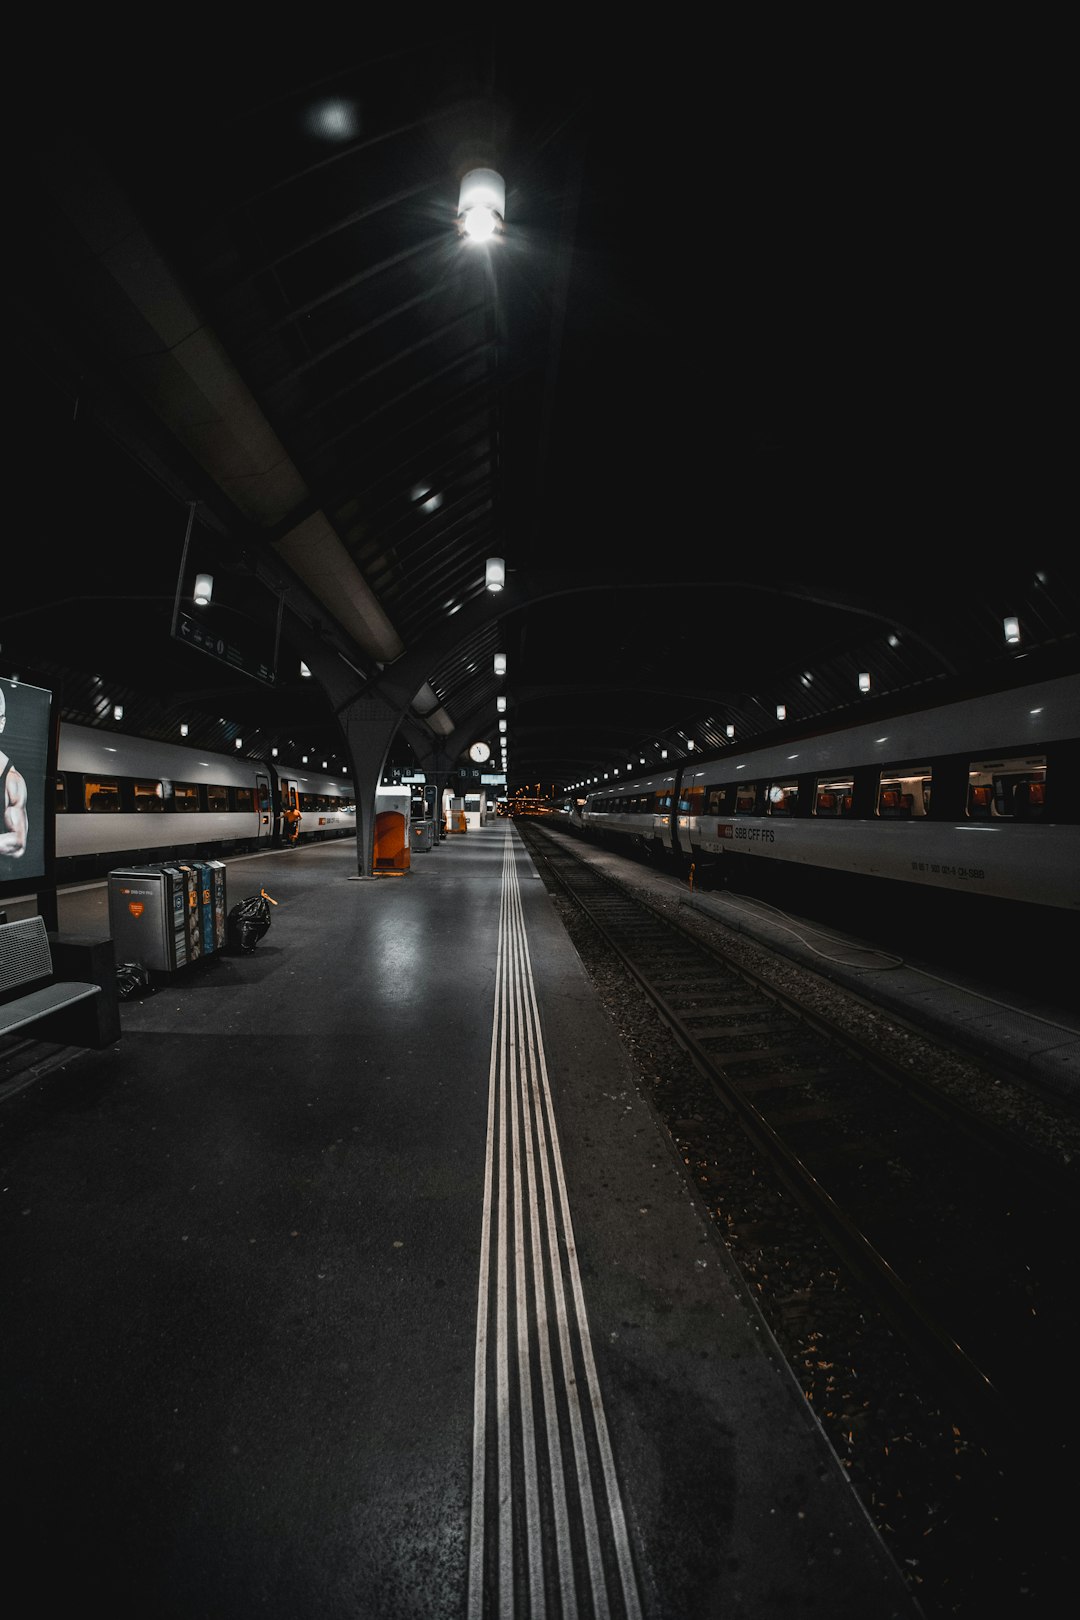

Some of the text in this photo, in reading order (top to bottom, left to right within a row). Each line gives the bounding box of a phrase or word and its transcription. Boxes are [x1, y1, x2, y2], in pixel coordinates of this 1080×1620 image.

[472, 769, 479, 777] 15
[735, 827, 775, 843] SBB CFF FFS
